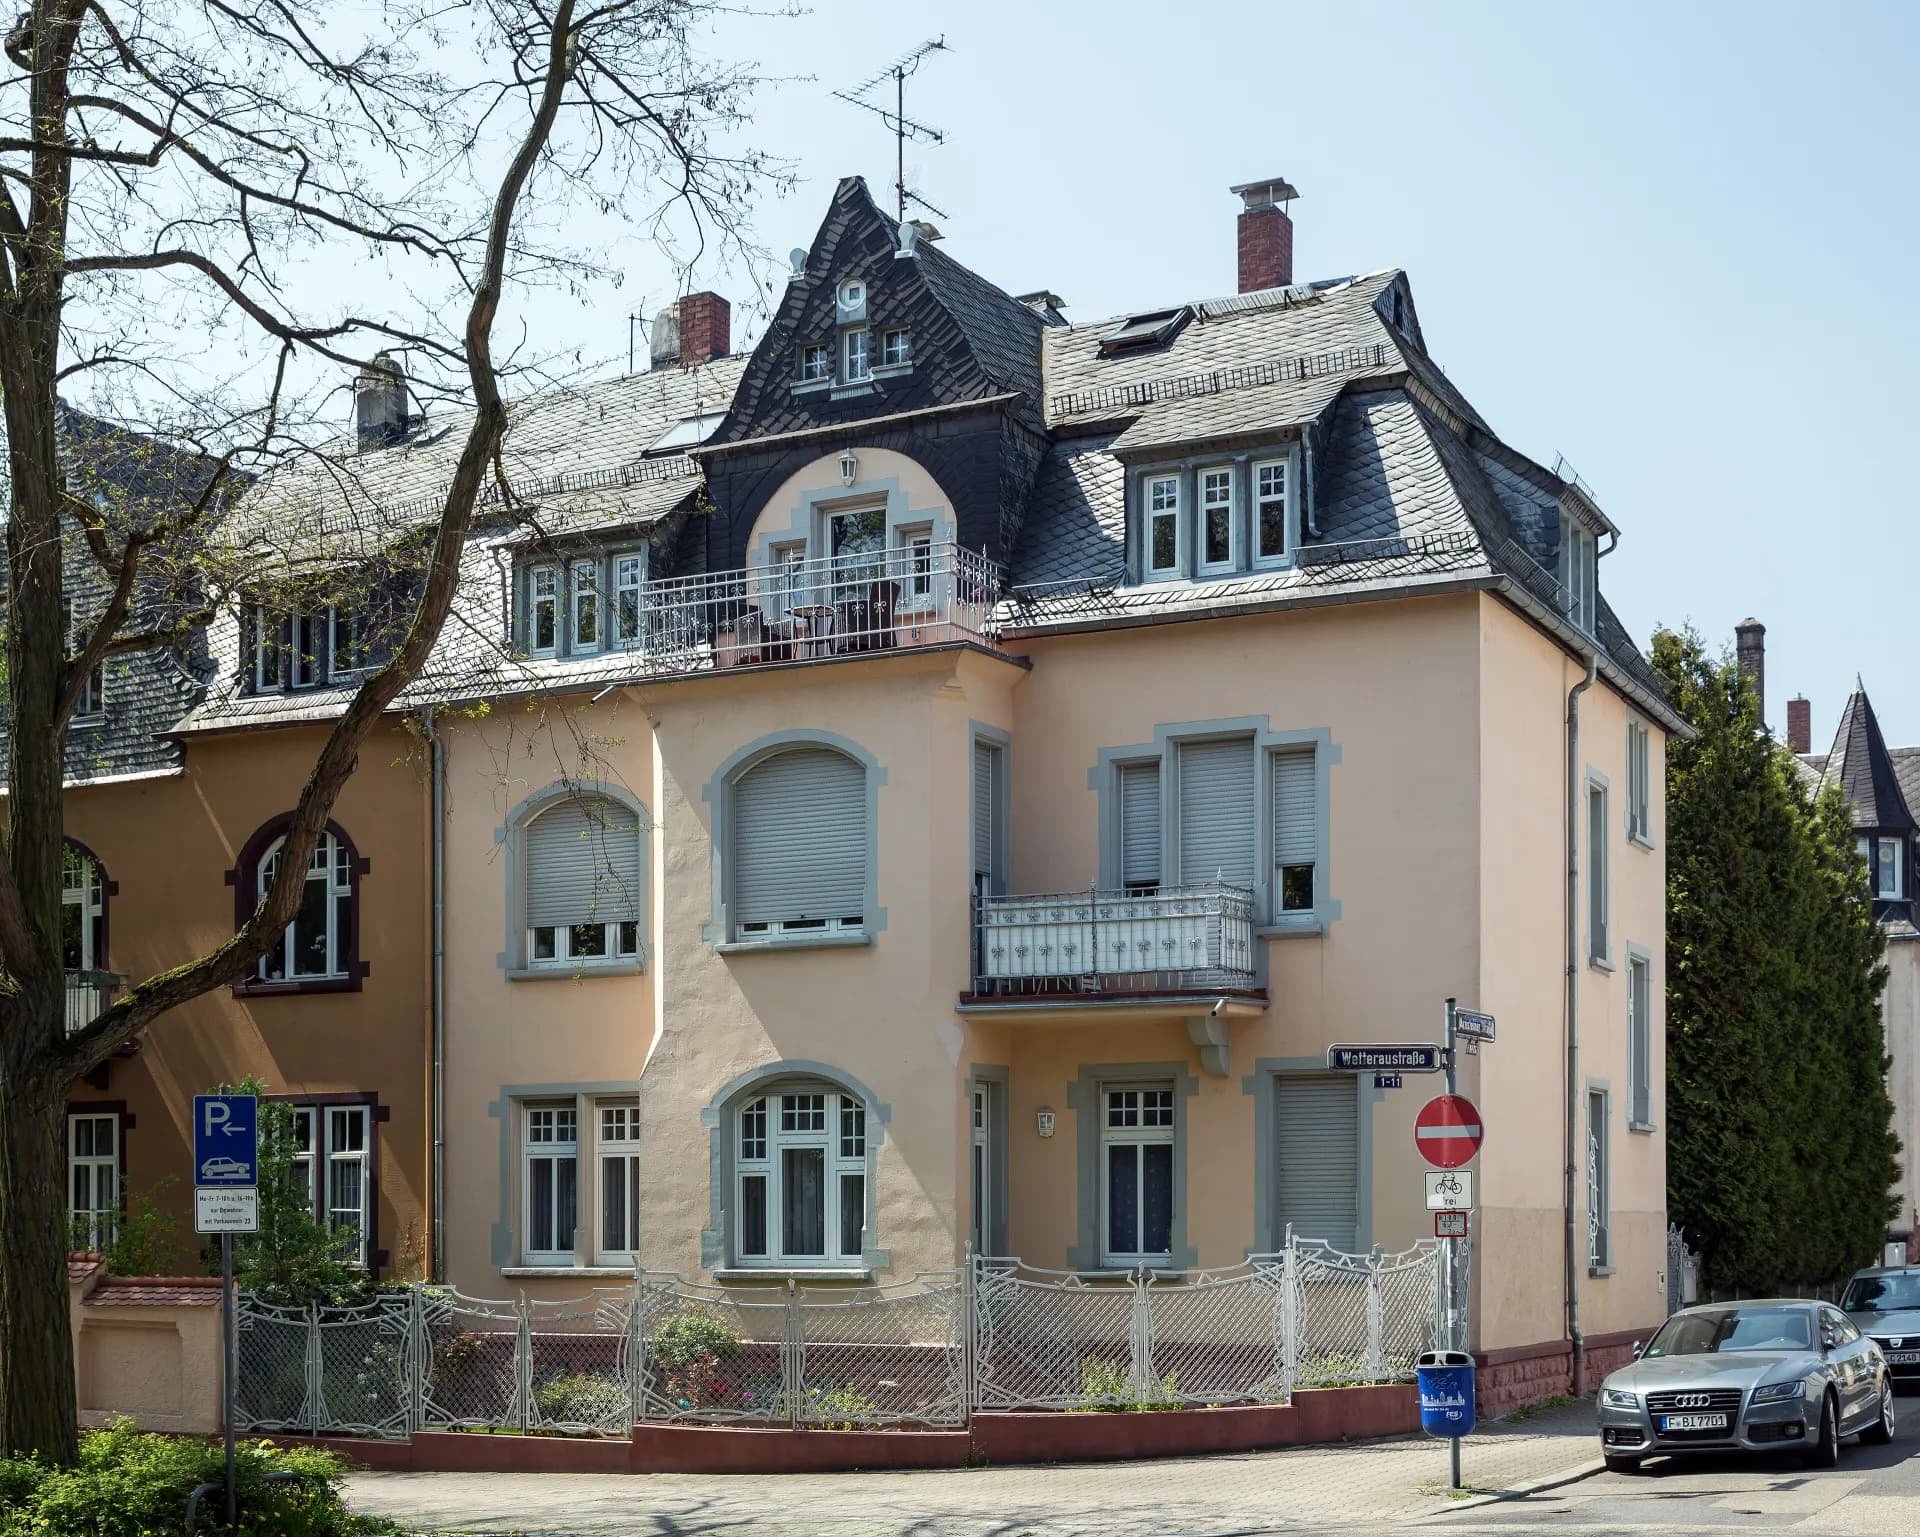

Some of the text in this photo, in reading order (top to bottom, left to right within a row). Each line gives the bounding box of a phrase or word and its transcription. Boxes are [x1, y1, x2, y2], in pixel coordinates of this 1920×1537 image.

[1341, 1050, 1425, 1066] Wetteraustraße
[1380, 1077, 1400, 1087] 1-11
[204, 1101, 231, 1137] P
